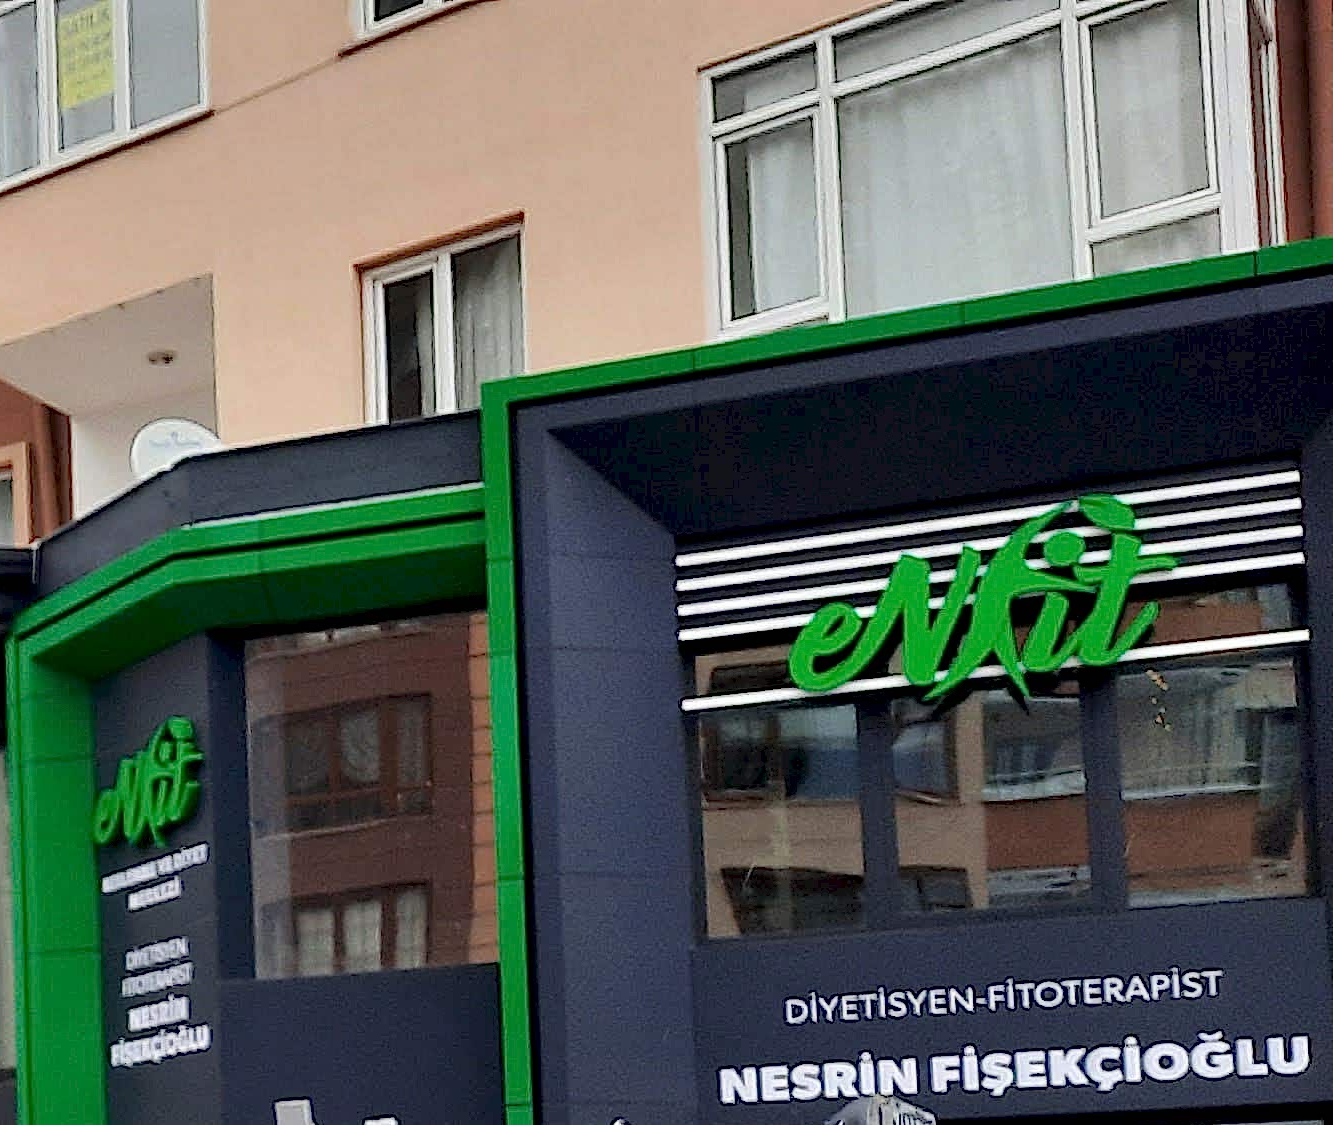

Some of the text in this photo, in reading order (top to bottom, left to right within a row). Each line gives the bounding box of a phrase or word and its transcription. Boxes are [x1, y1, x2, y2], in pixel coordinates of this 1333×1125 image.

[784, 967, 1224, 1026] DİYETİSYEN-FİTOTERAPİST
[718, 1032, 1311, 1105] NESRİN FİŞEKÇİOĞLU
